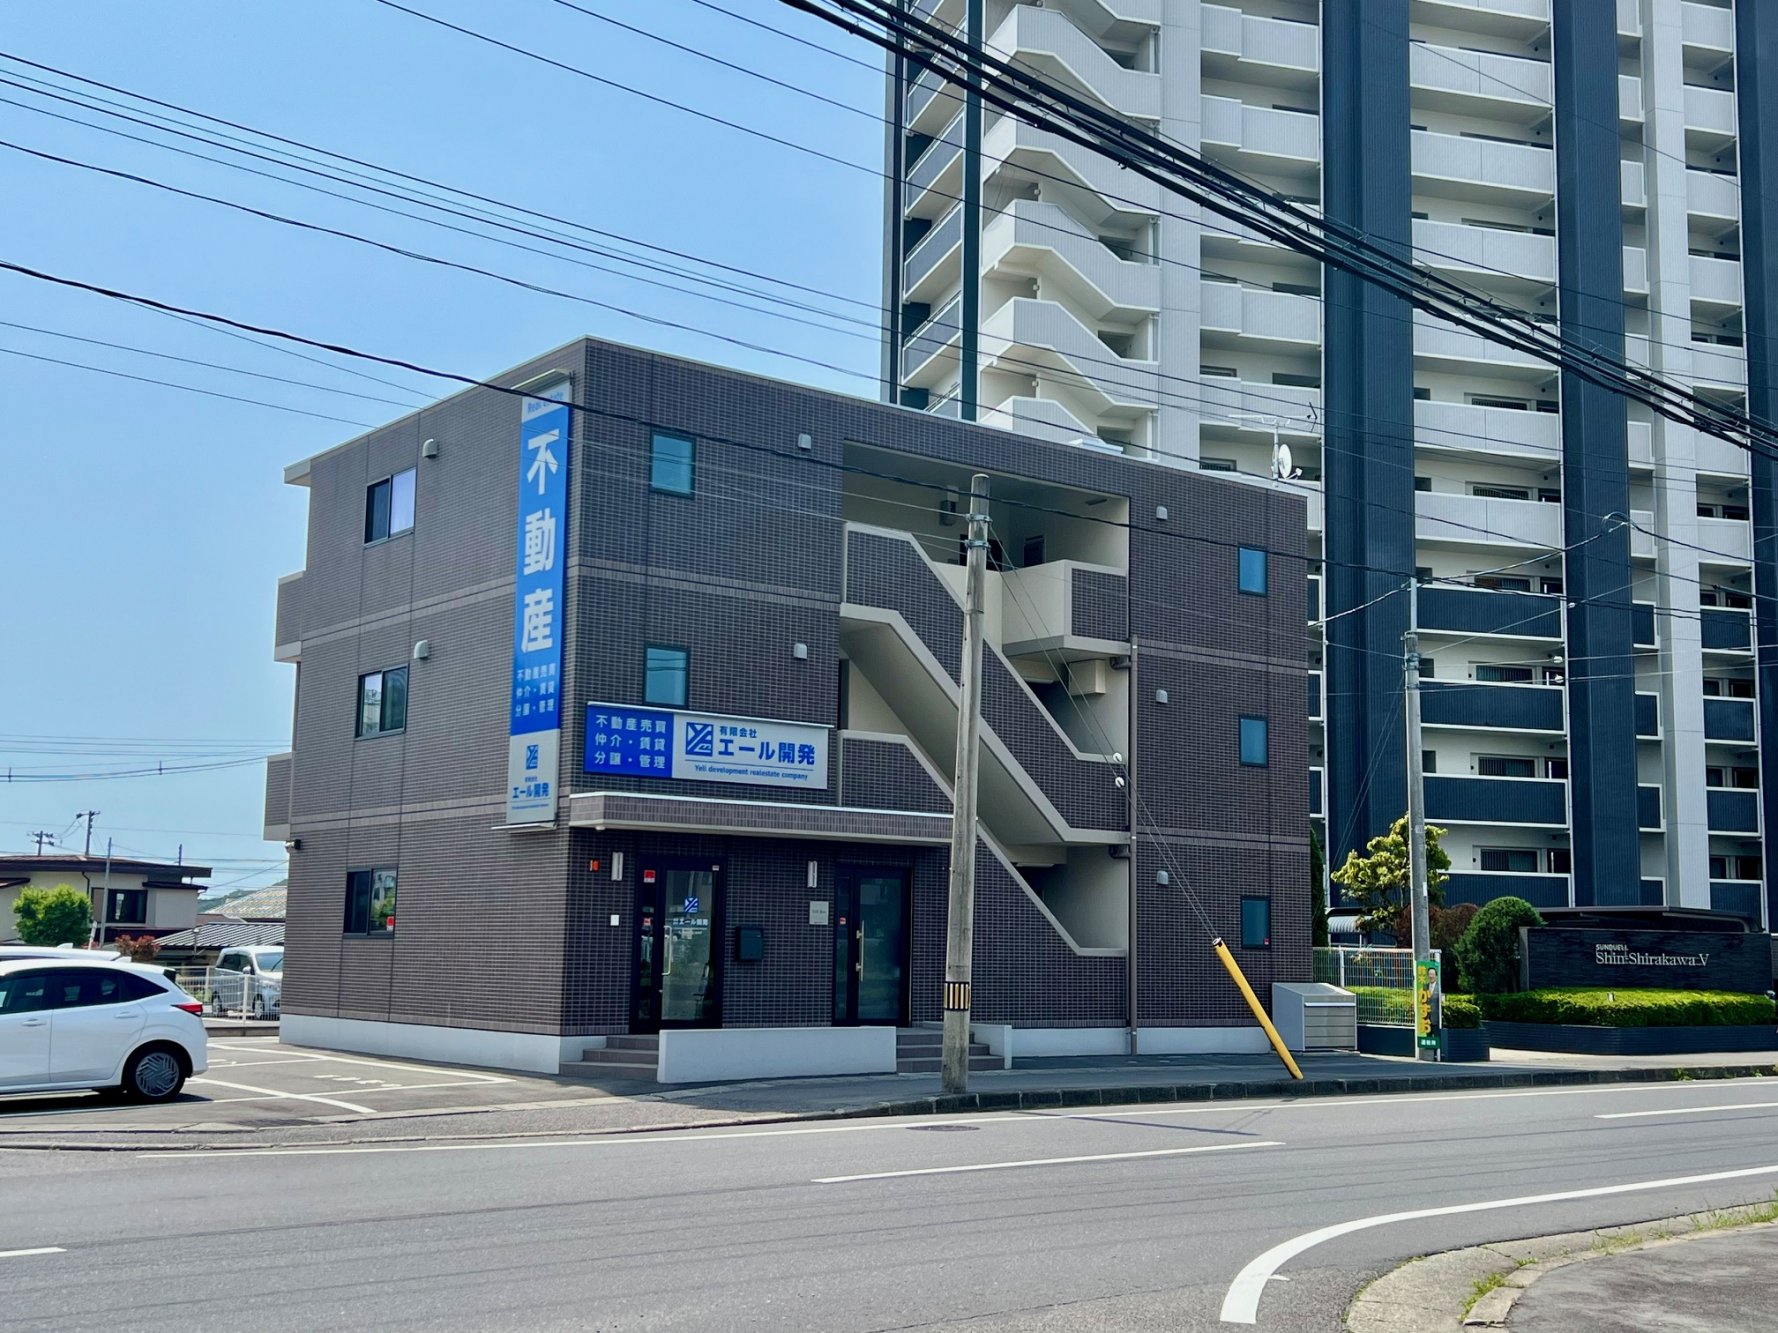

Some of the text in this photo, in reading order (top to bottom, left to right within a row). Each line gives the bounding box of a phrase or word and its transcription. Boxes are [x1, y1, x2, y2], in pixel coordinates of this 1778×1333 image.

[521, 428, 560, 653] 不動産
[596, 714, 667, 734] 不動産売買
[719, 725, 757, 739] 有限会社
[595, 732, 666, 751] 仲介・賃貸
[718, 738, 816, 765] エール開発
[708, 766, 748, 778] development
[781, 772, 808, 782] company
